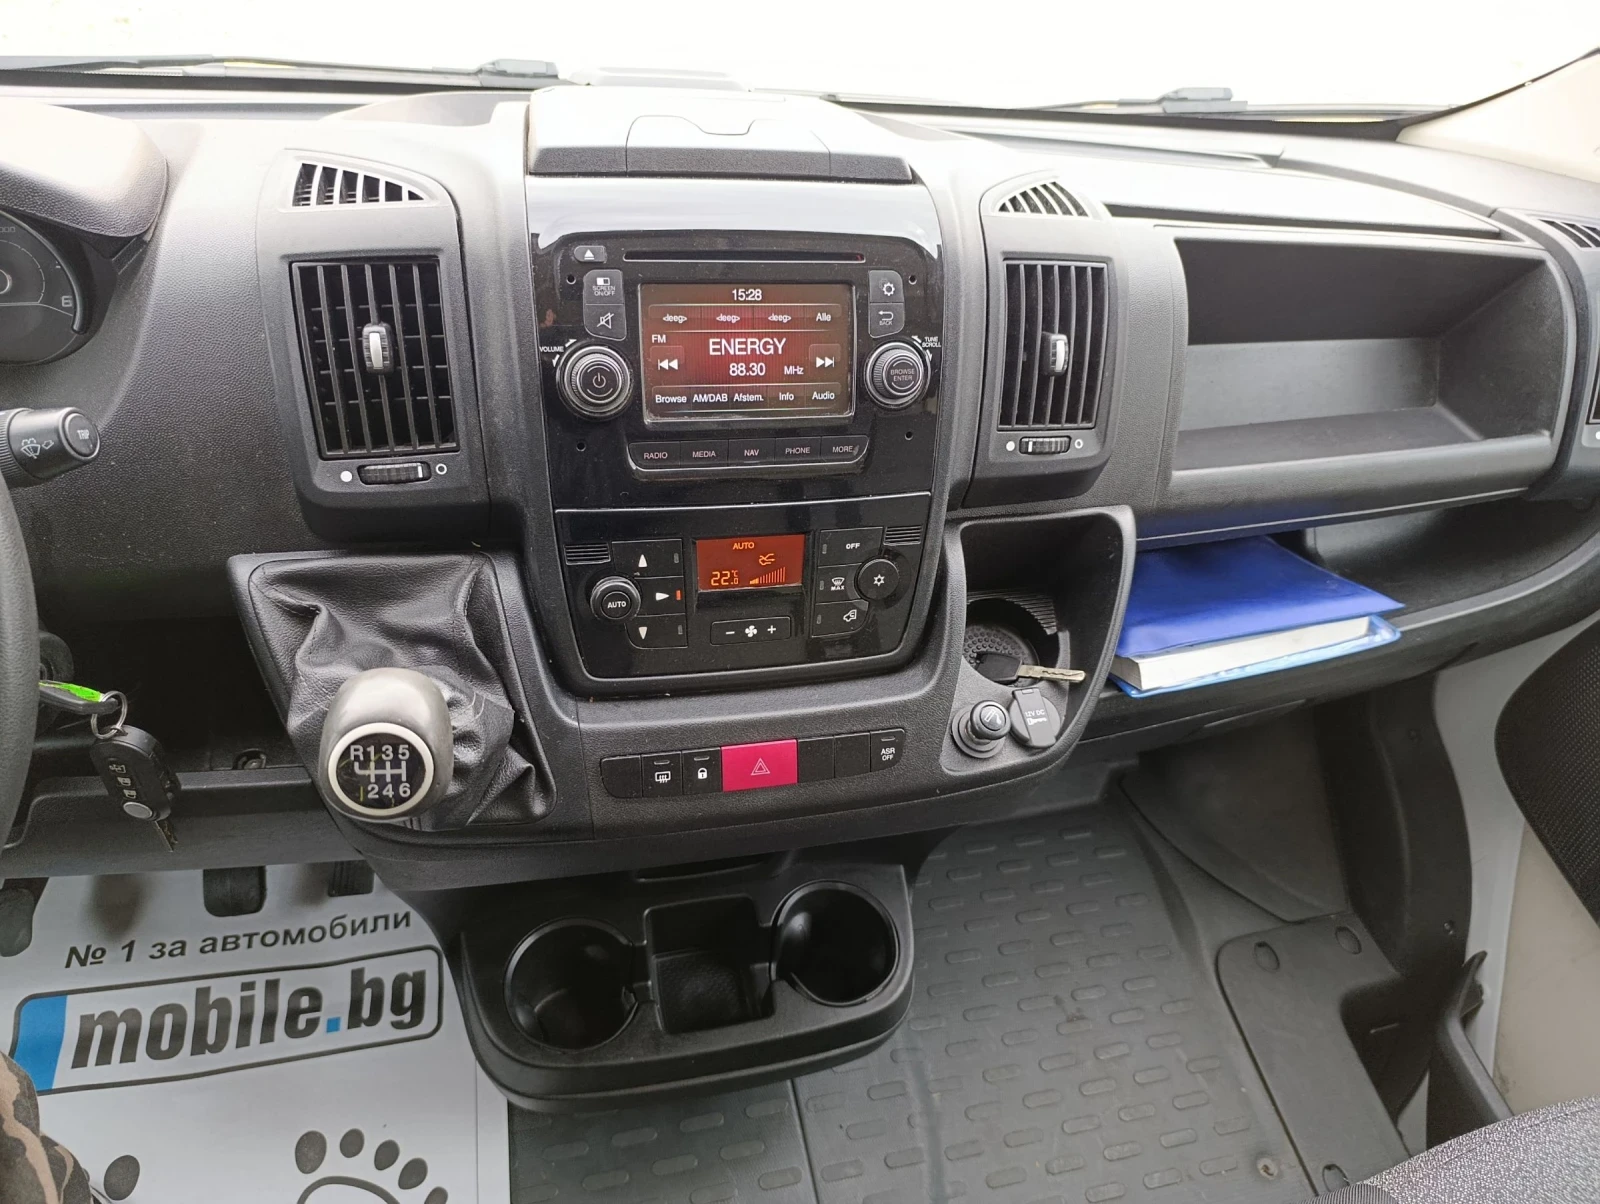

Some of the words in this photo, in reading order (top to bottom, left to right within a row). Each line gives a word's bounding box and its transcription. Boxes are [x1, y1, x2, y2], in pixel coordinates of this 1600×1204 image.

[732, 288, 762, 301] 15:28
[815, 312, 832, 322] Alle
[651, 334, 667, 344] FM
[539, 345, 565, 353] VOLUME
[708, 337, 787, 356] ENERGY
[729, 362, 766, 377] 88.30
[783, 364, 805, 375] MHz
[893, 374, 913, 382] ENTER
[655, 394, 687, 404] Browse
[692, 393, 728, 403] AM/DAB
[733, 391, 764, 403] Afstem.
[779, 391, 795, 401] Info
[812, 390, 835, 401] Audio
[692, 450, 716, 458] MEDIA
[744, 449, 760, 457] NAV
[785, 446, 811, 455] PHONE
[832, 445, 853, 453] MORE
[732, 541, 755, 550] AUTO
[845, 542, 861, 550] OFF
[607, 600, 627, 609] AUTO
[1025, 710, 1035, 718] 12V
[350, 744, 364, 761] R
[880, 747, 896, 755] ASR
[121, 939, 136, 963] 1
[149, 938, 188, 960] за
[199, 910, 412, 955] автомобили
[70, 967, 428, 1070] mobile.bg
